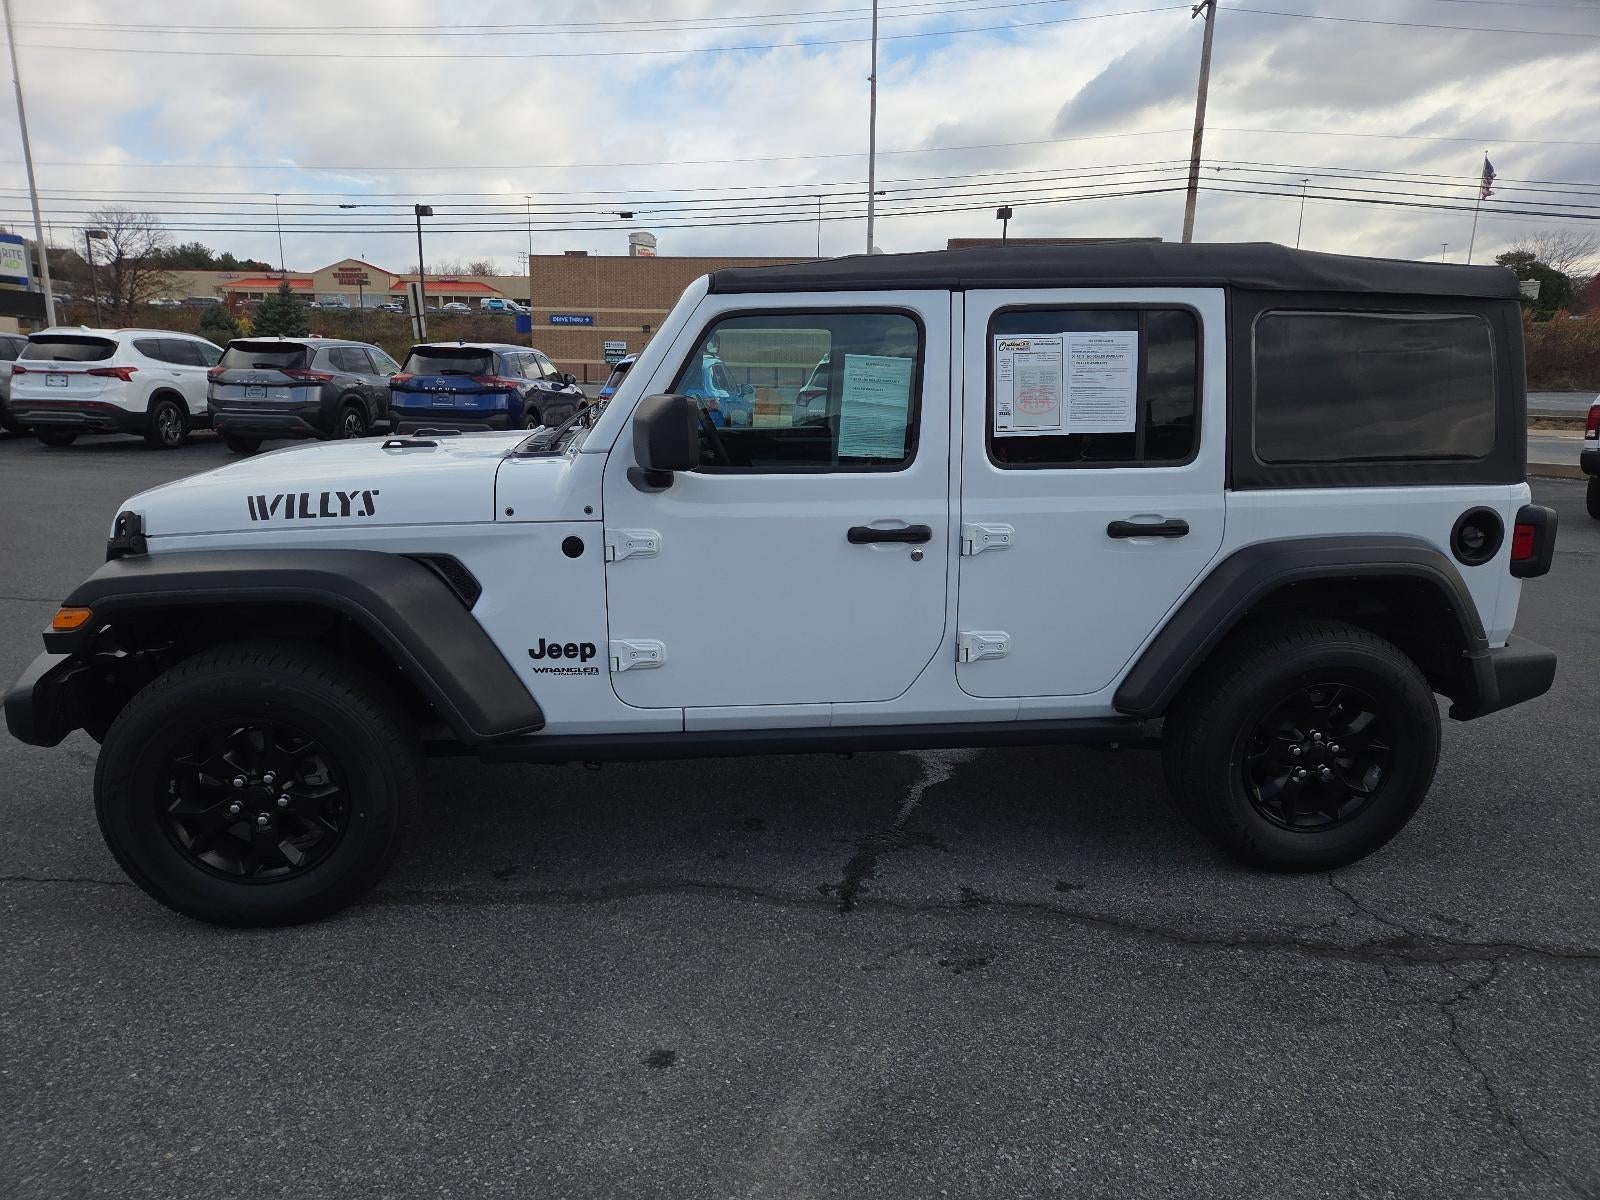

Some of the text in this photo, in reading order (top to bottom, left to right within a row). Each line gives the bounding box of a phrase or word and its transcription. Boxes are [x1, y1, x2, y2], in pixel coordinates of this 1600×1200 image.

[2, 248, 23, 260] RITE
[247, 490, 380, 520] WILLYS
[528, 638, 596, 662] Jeep
